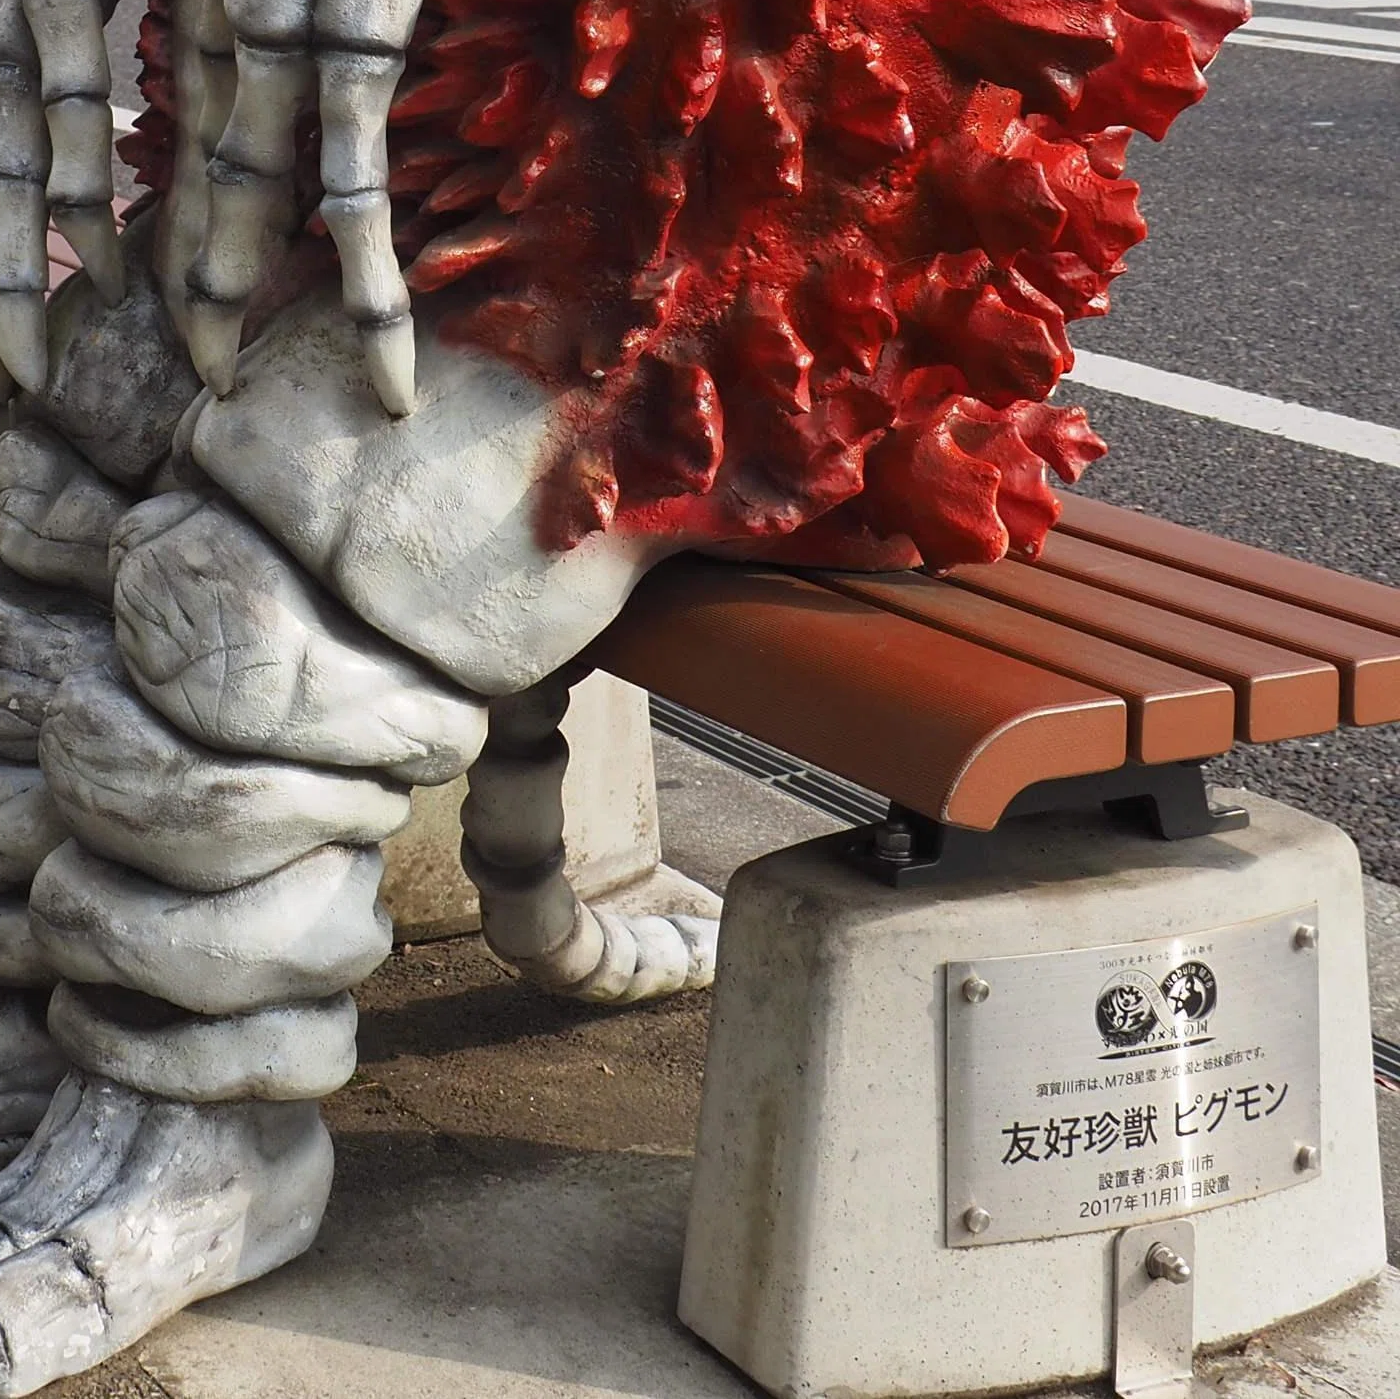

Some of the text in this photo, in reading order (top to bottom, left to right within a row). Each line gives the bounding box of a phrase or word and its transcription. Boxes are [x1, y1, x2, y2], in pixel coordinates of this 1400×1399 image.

[1001, 1082, 1289, 1164] 友好珍獣 ピグモン
